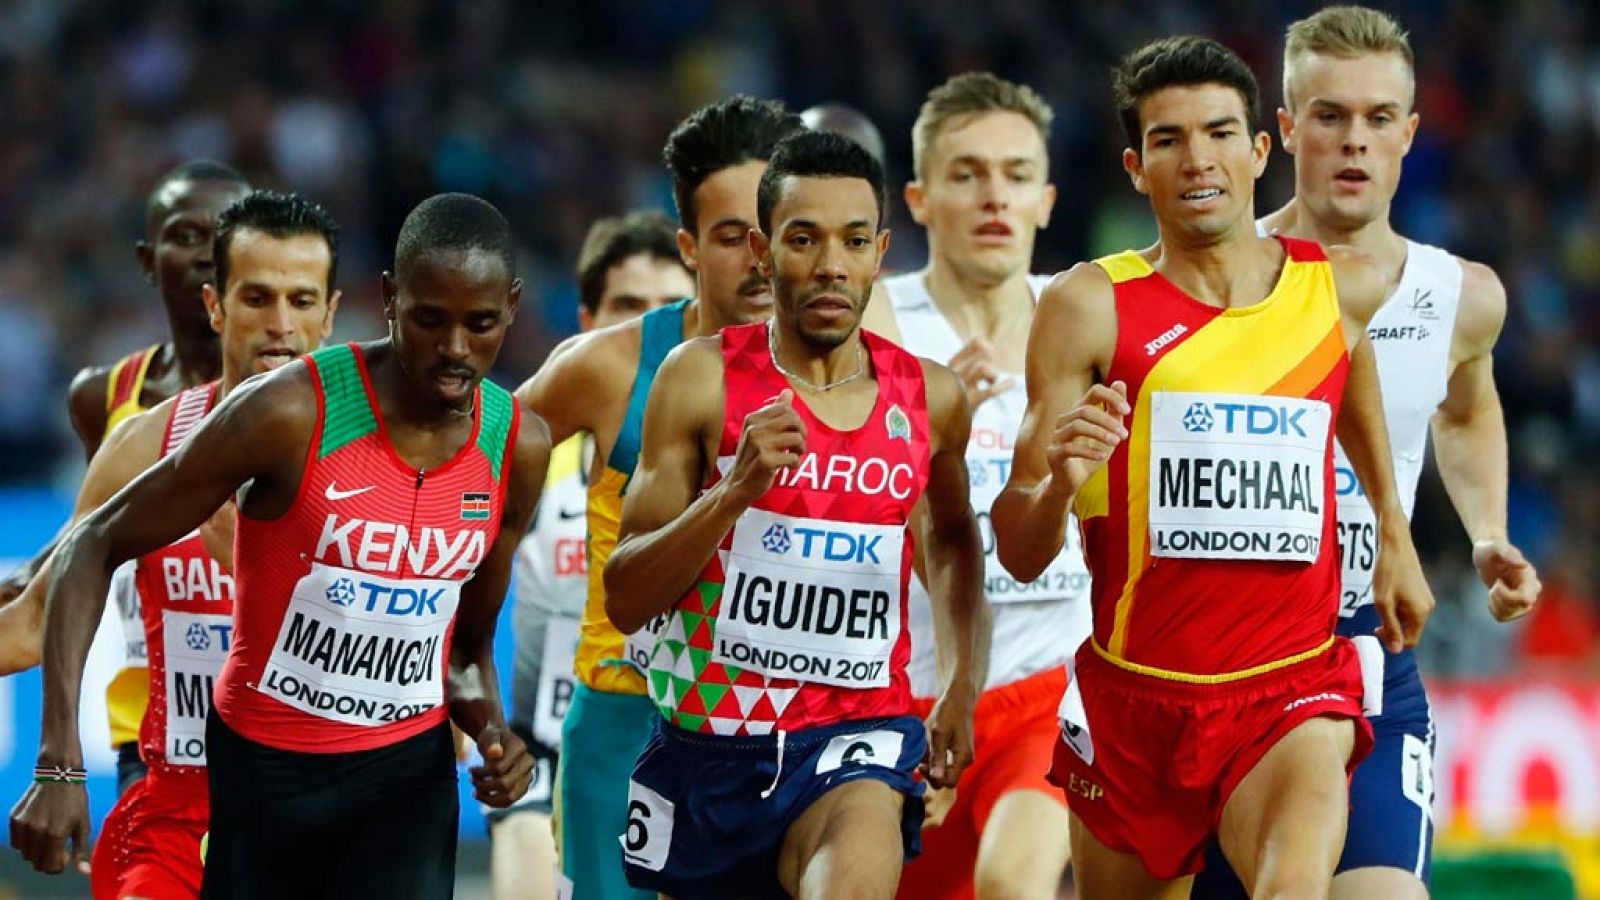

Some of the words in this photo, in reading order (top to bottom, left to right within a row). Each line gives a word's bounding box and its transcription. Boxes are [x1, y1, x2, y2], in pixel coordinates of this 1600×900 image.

[1368, 327, 1416, 340] CRAFT
[1214, 403, 1307, 437] TDK
[1158, 457, 1320, 515] MECHAAL
[314, 513, 486, 578] KENYA
[794, 527, 883, 565] TDK
[1157, 531, 1271, 551] LONDON
[1276, 532, 1320, 556] 2017
[359, 581, 446, 616] TDK
[728, 572, 889, 640] IGUIDER
[283, 612, 440, 687] MANANGOI
[719, 640, 831, 675] LONDON
[836, 660, 884, 681] 2017
[266, 670, 377, 719] LONDON
[1069, 772, 1104, 801] ESP
[626, 800, 651, 851] 6
